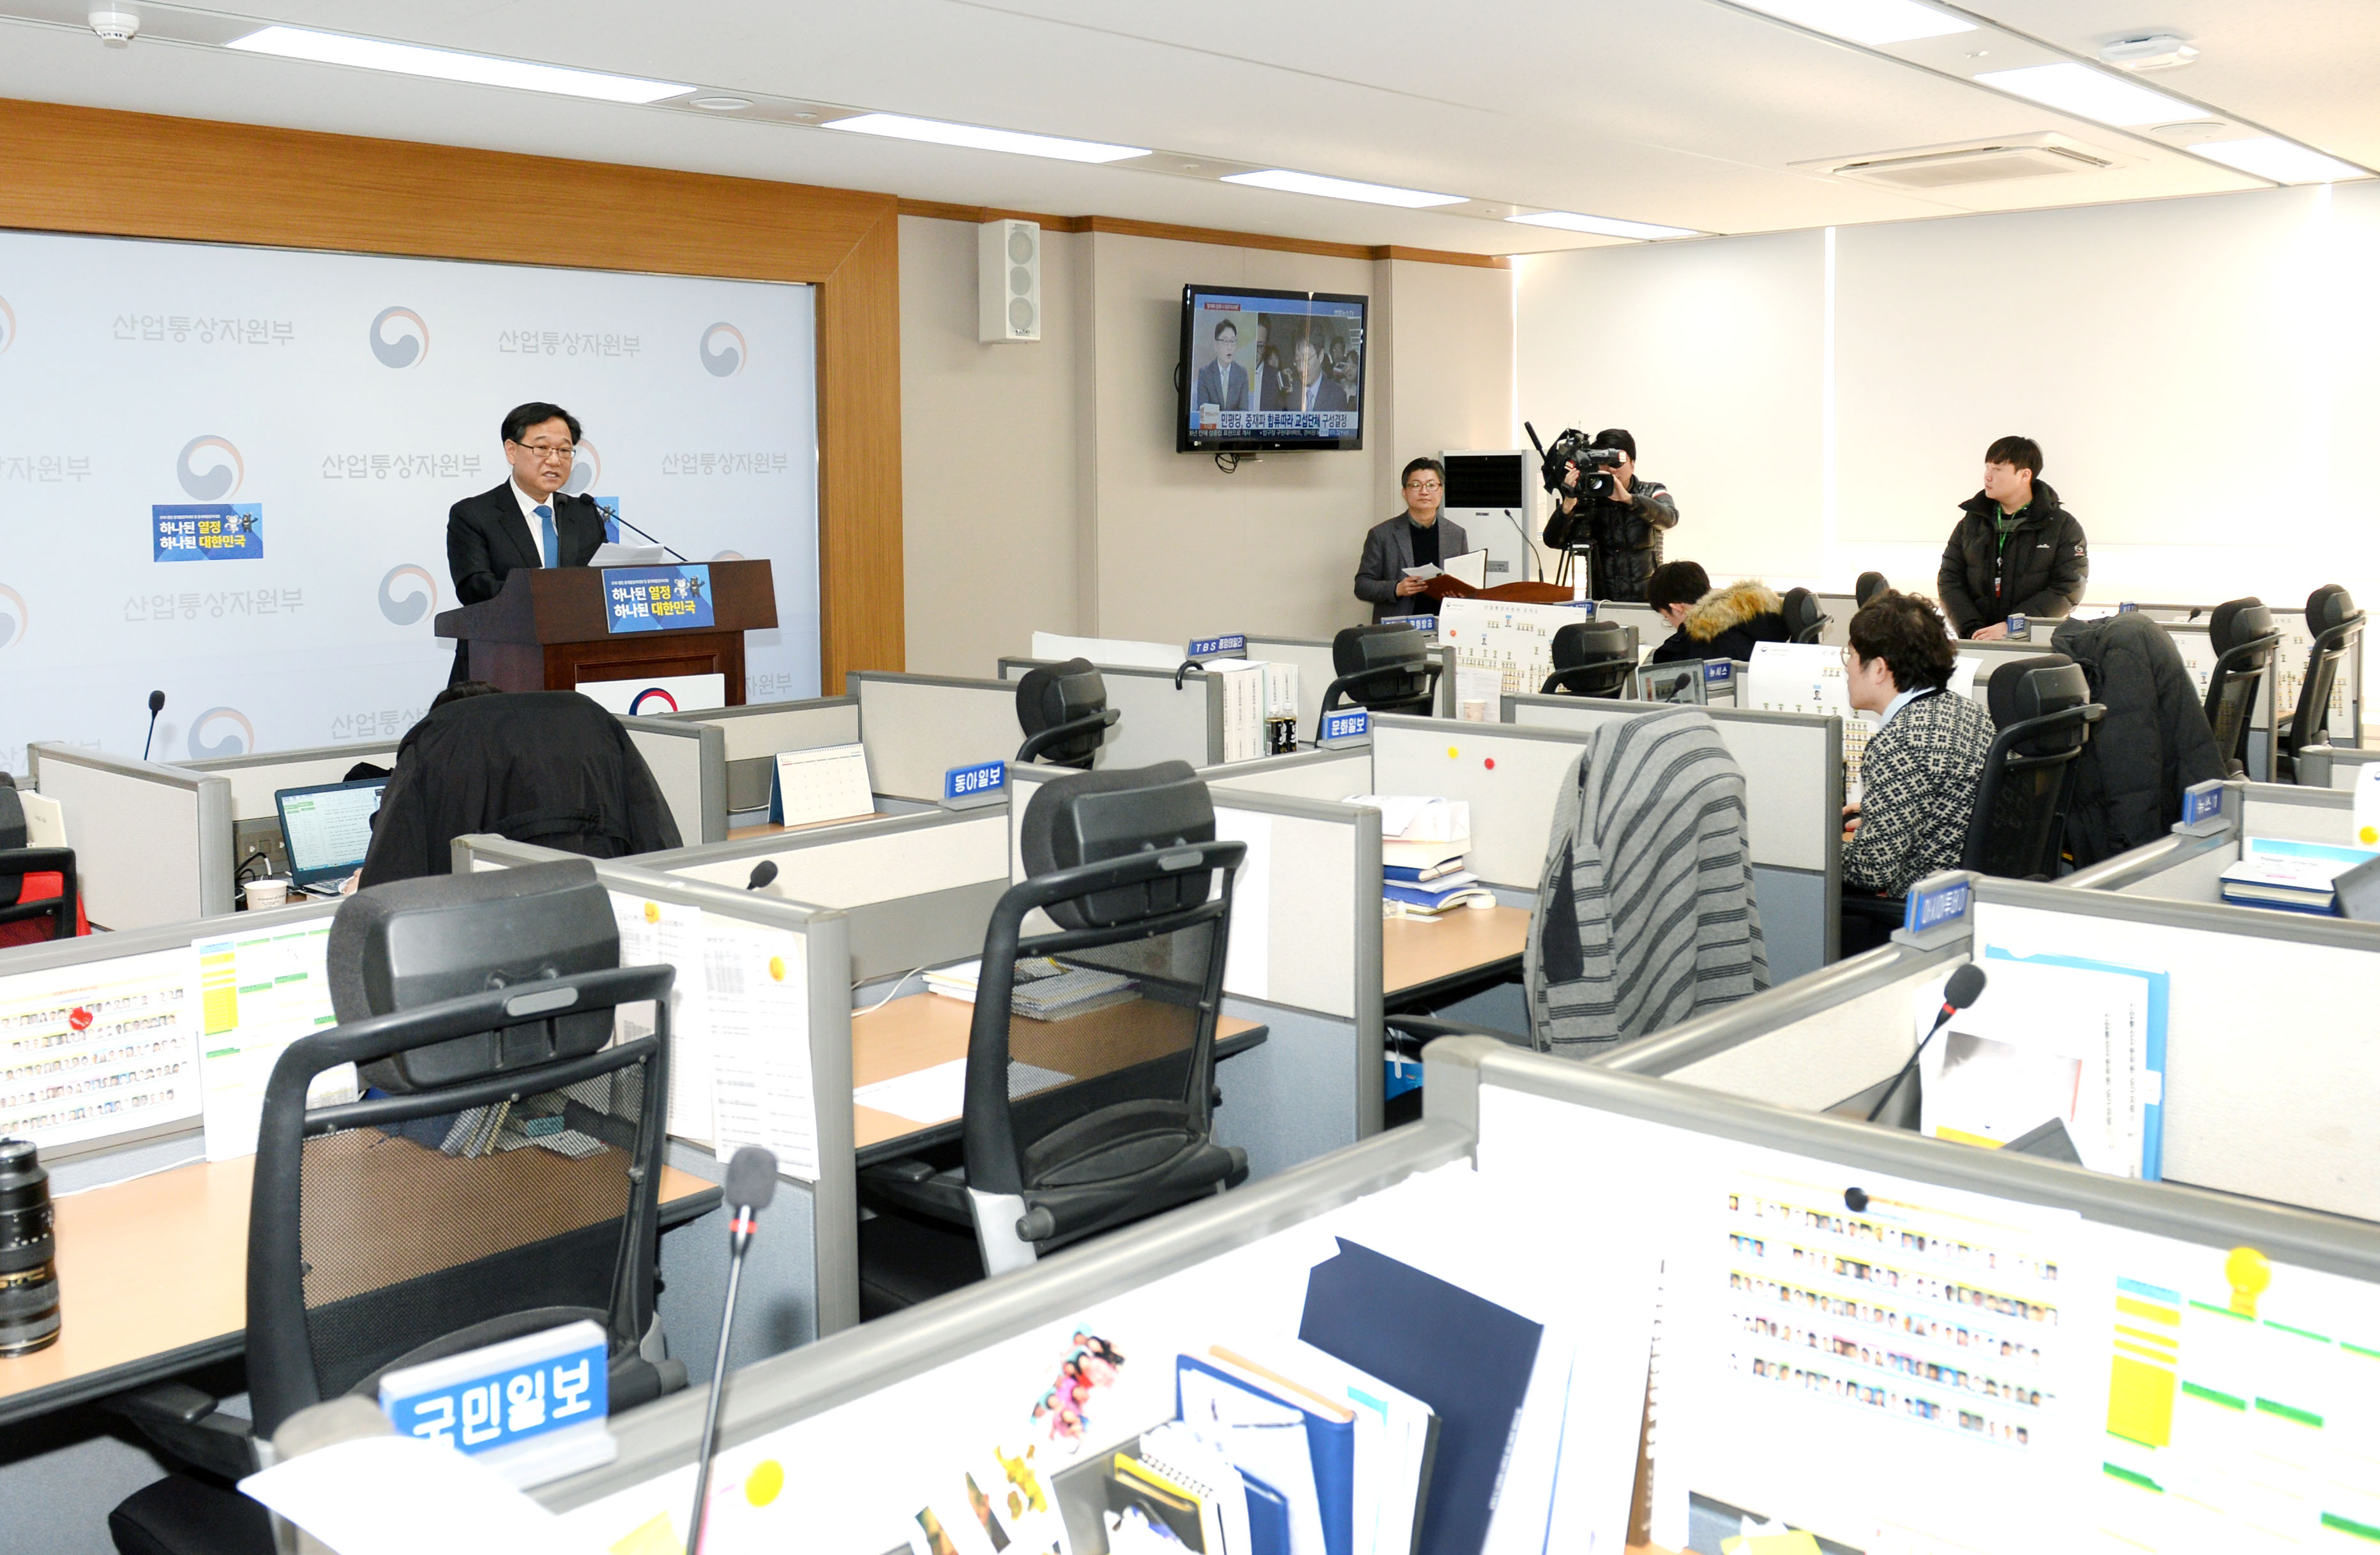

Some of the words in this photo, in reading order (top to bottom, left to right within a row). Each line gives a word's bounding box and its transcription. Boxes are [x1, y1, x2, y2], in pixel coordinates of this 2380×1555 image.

[112, 313, 294, 345] 산업통상자원부
[499, 329, 641, 357] 산업통상자원부
[1246, 413, 1266, 428] 중재파
[1267, 413, 1293, 428] 합류따라
[1295, 413, 1320, 428] 교섭단체
[1322, 413, 1347, 428] 구성결정
[0, 455, 91, 483] 자원부
[322, 454, 482, 479] 산업통상자원부
[661, 453, 788, 476] 산업통상자원부
[160, 521, 195, 535] 하나된
[198, 520, 221, 534] 열정
[160, 536, 197, 550] 하나된
[199, 534, 246, 548] 대한민국
[124, 588, 303, 622] 산업통상자원부
[611, 586, 647, 602] 하나된
[649, 585, 671, 600] 열정
[614, 603, 649, 619] 하나된
[651, 600, 696, 616] 대한민국
[1196, 642, 1217, 652] TBS
[1709, 666, 1728, 677] 뉴시스
[331, 708, 429, 740] 산업통상
[1332, 717, 1365, 736] 문화일보
[954, 766, 1000, 793] 동아일보
[412, 1358, 592, 1448] 국민일보
